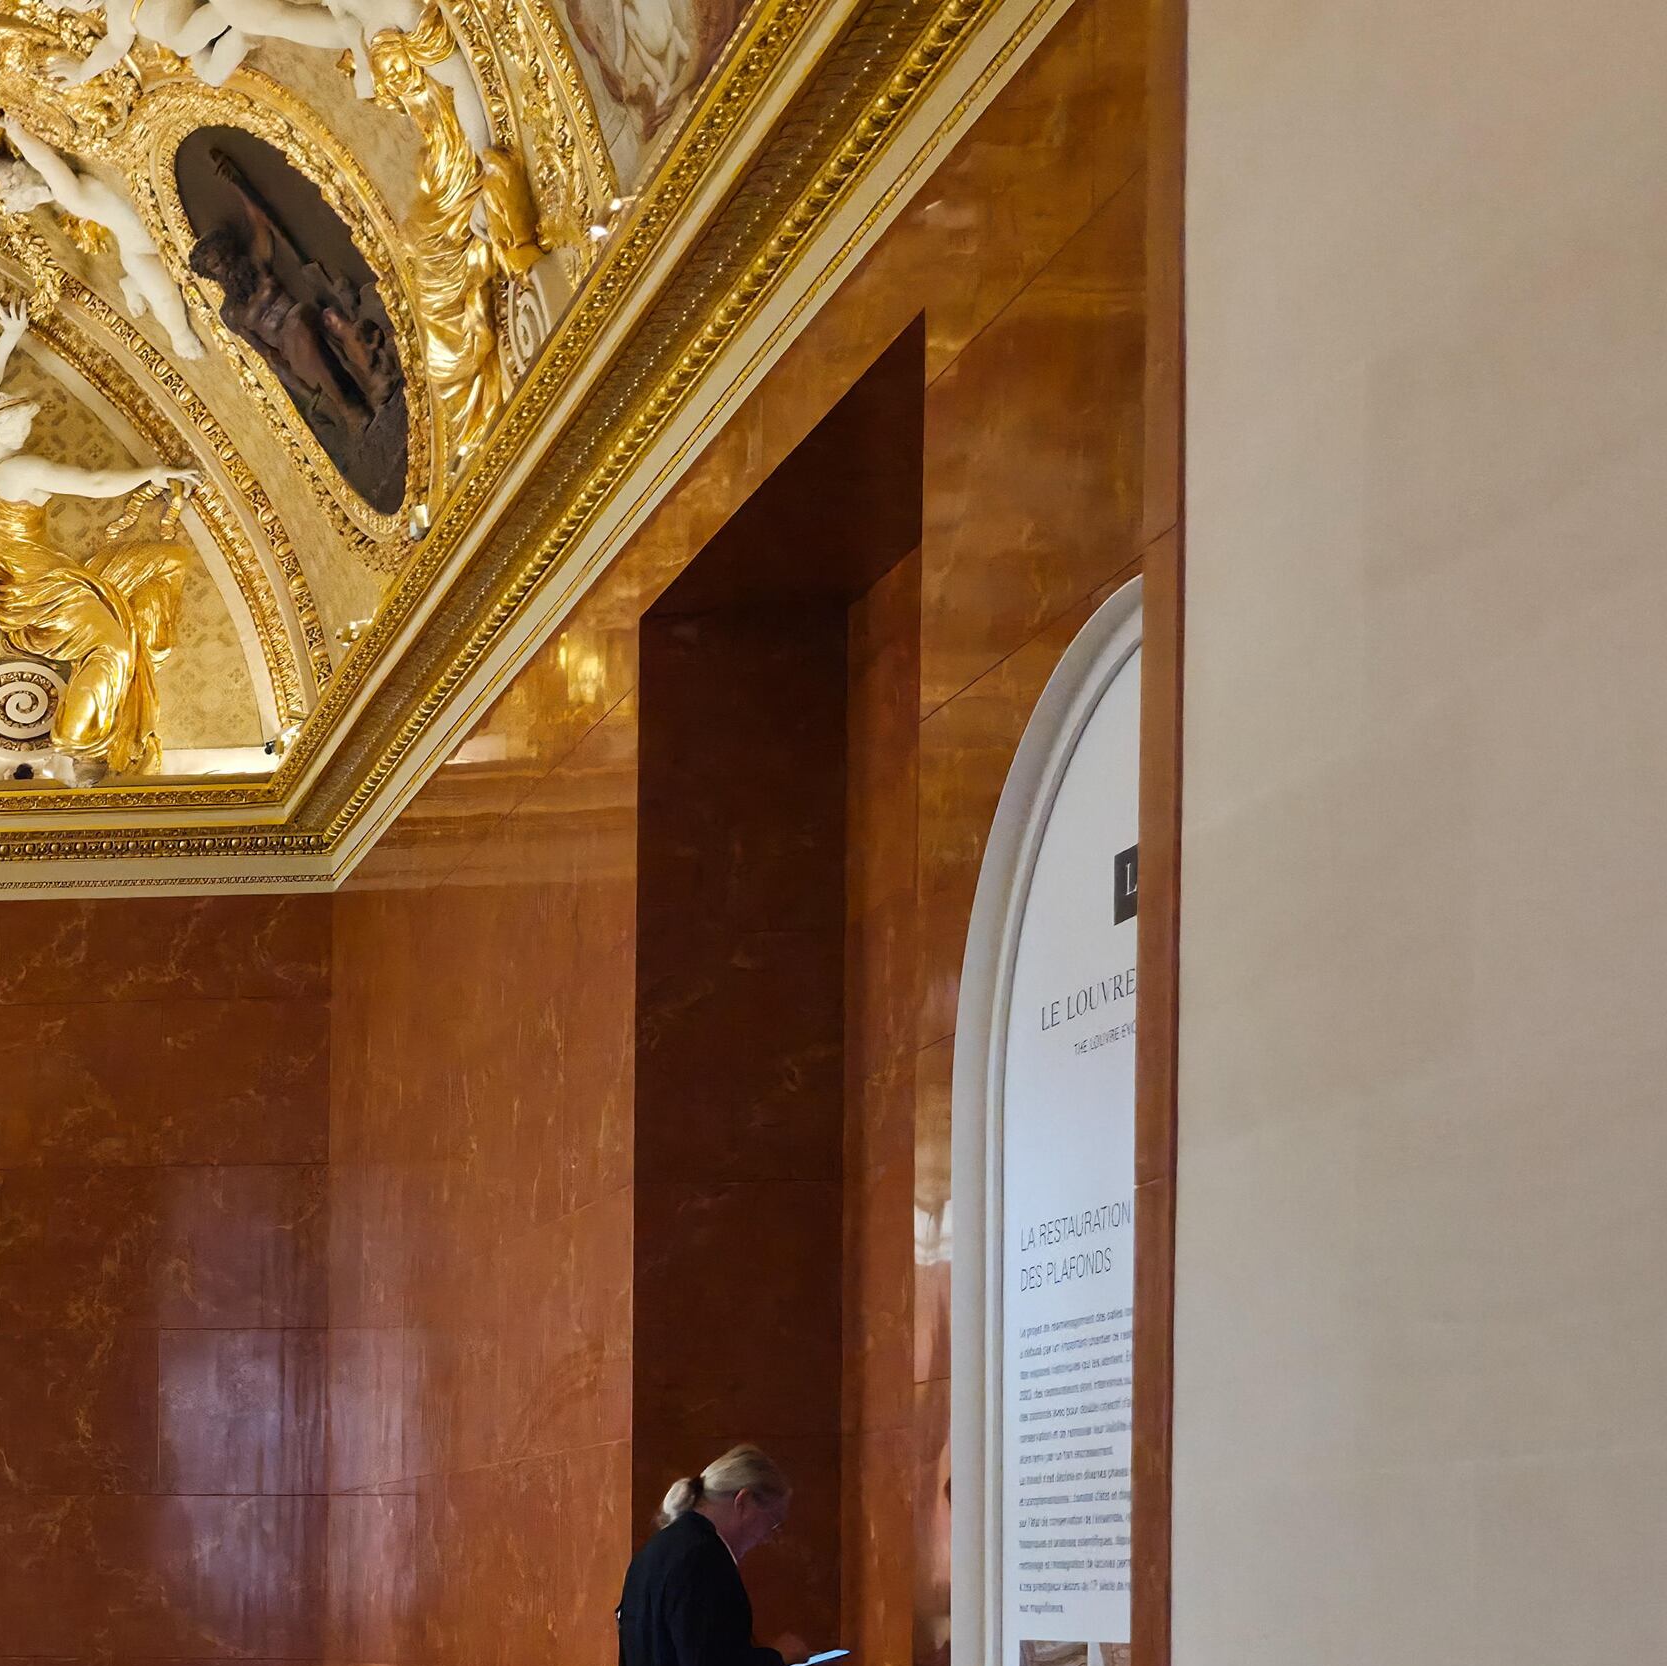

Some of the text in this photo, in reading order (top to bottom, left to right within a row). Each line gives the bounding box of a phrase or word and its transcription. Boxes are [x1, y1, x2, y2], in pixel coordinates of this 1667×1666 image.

[1042, 968, 1136, 1031] LE LOUVRE
[1090, 1026, 1120, 1051] LOUVRE
[1020, 1200, 1131, 1252] LA RESTAURATION
[1020, 1247, 1112, 1292] DES PLAFONDS
